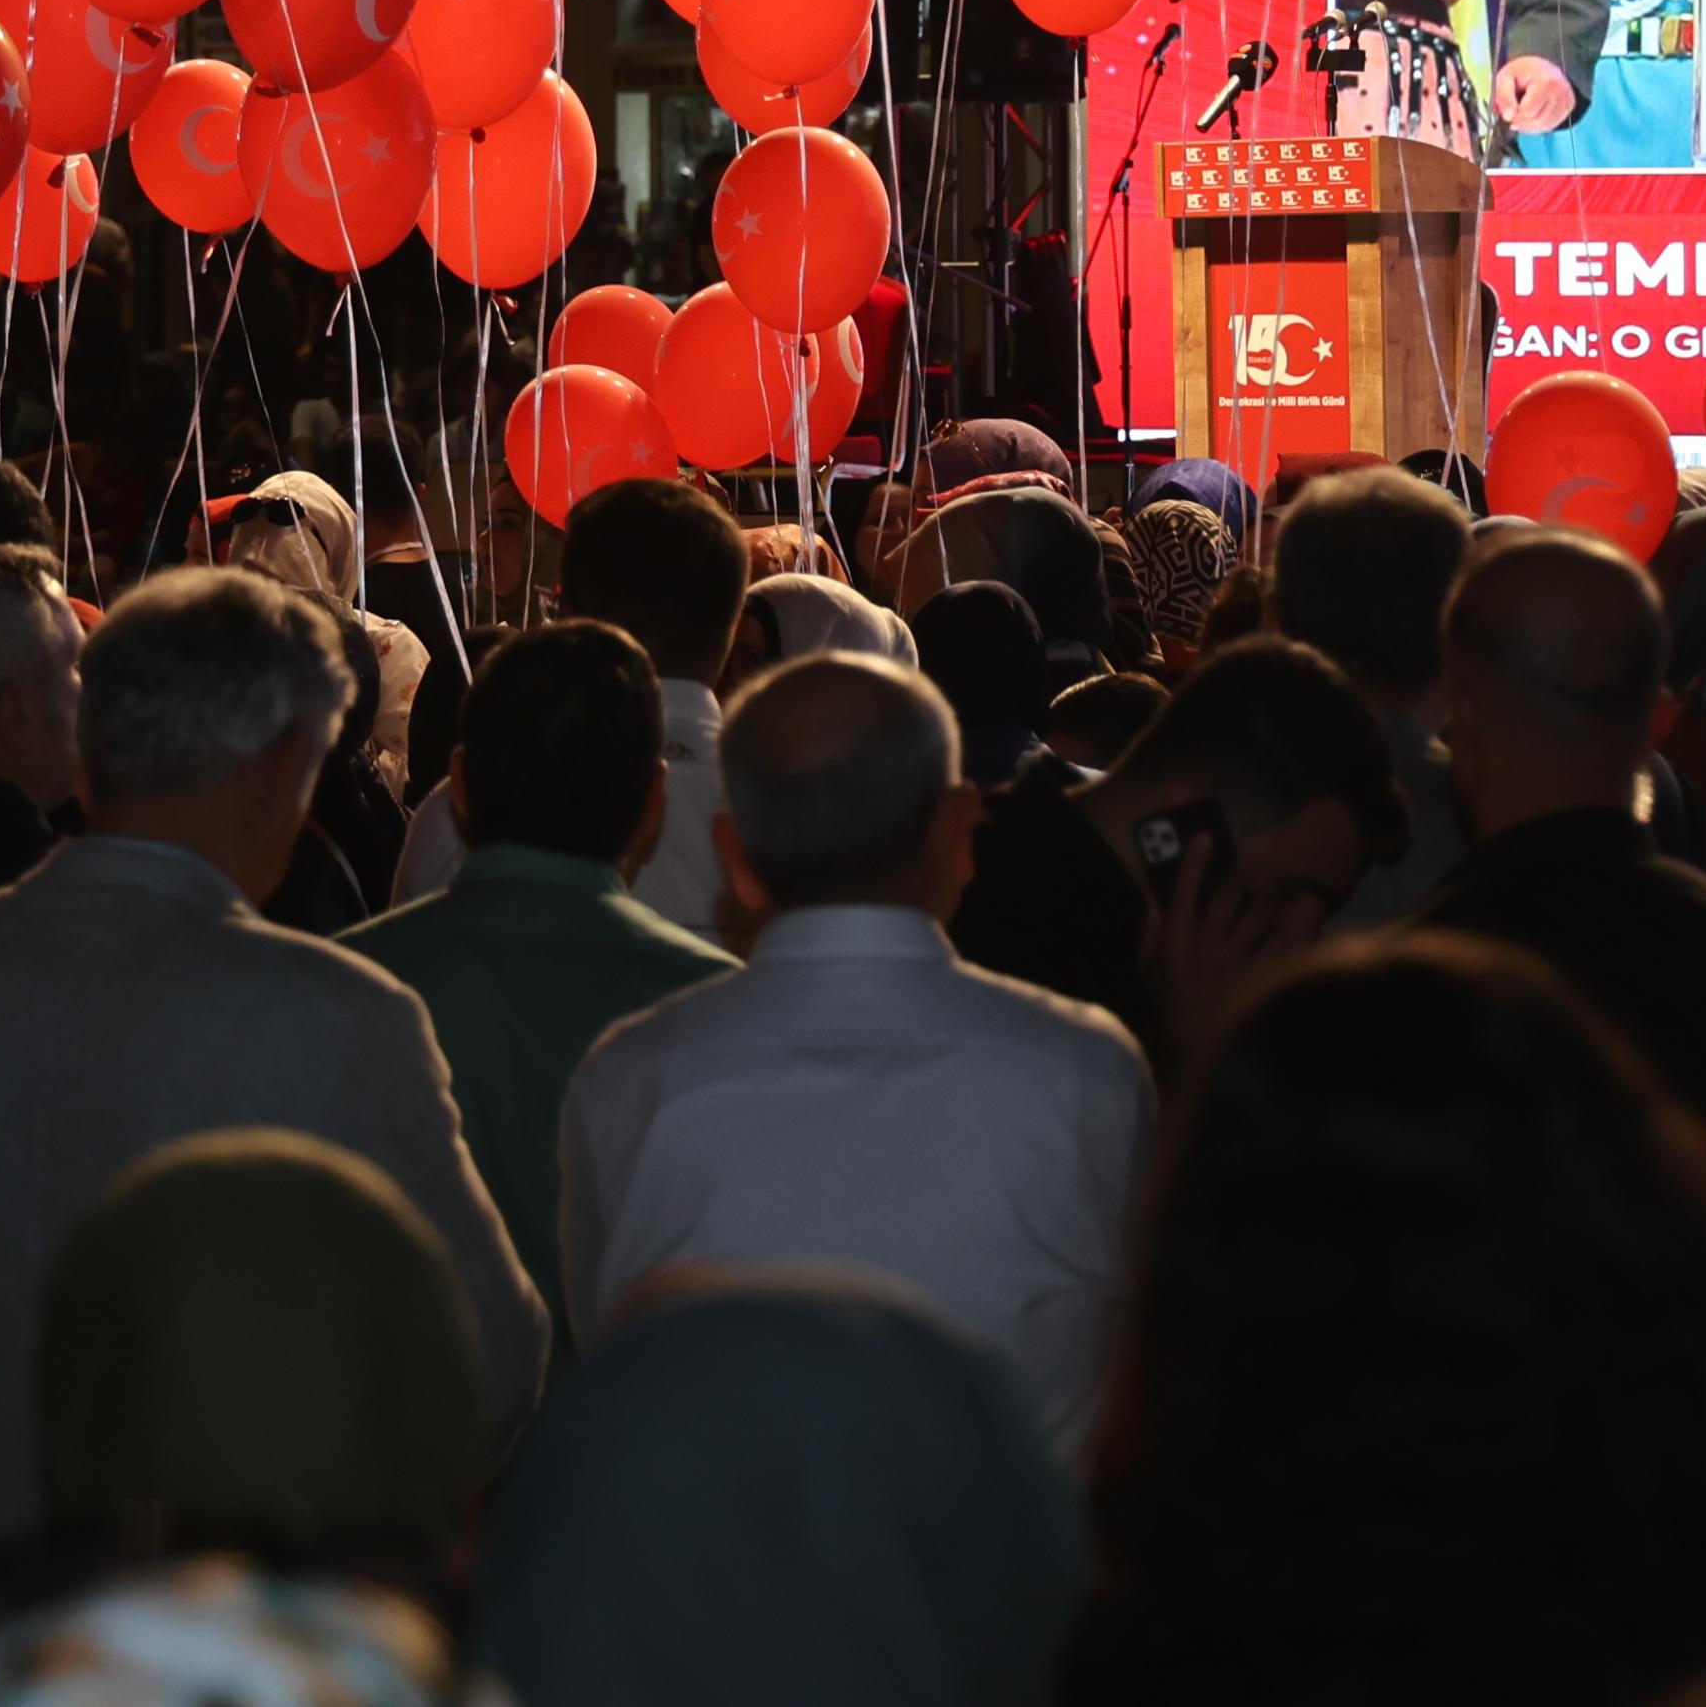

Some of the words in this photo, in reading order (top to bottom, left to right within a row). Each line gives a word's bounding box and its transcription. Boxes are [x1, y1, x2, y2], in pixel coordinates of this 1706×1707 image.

[1611, 325, 1651, 358] O
[1219, 396, 1265, 407] Deokrasi
[1278, 396, 1297, 407] Milli
[1298, 396, 1321, 407] Birlik
[1322, 396, 1346, 407] Günü
